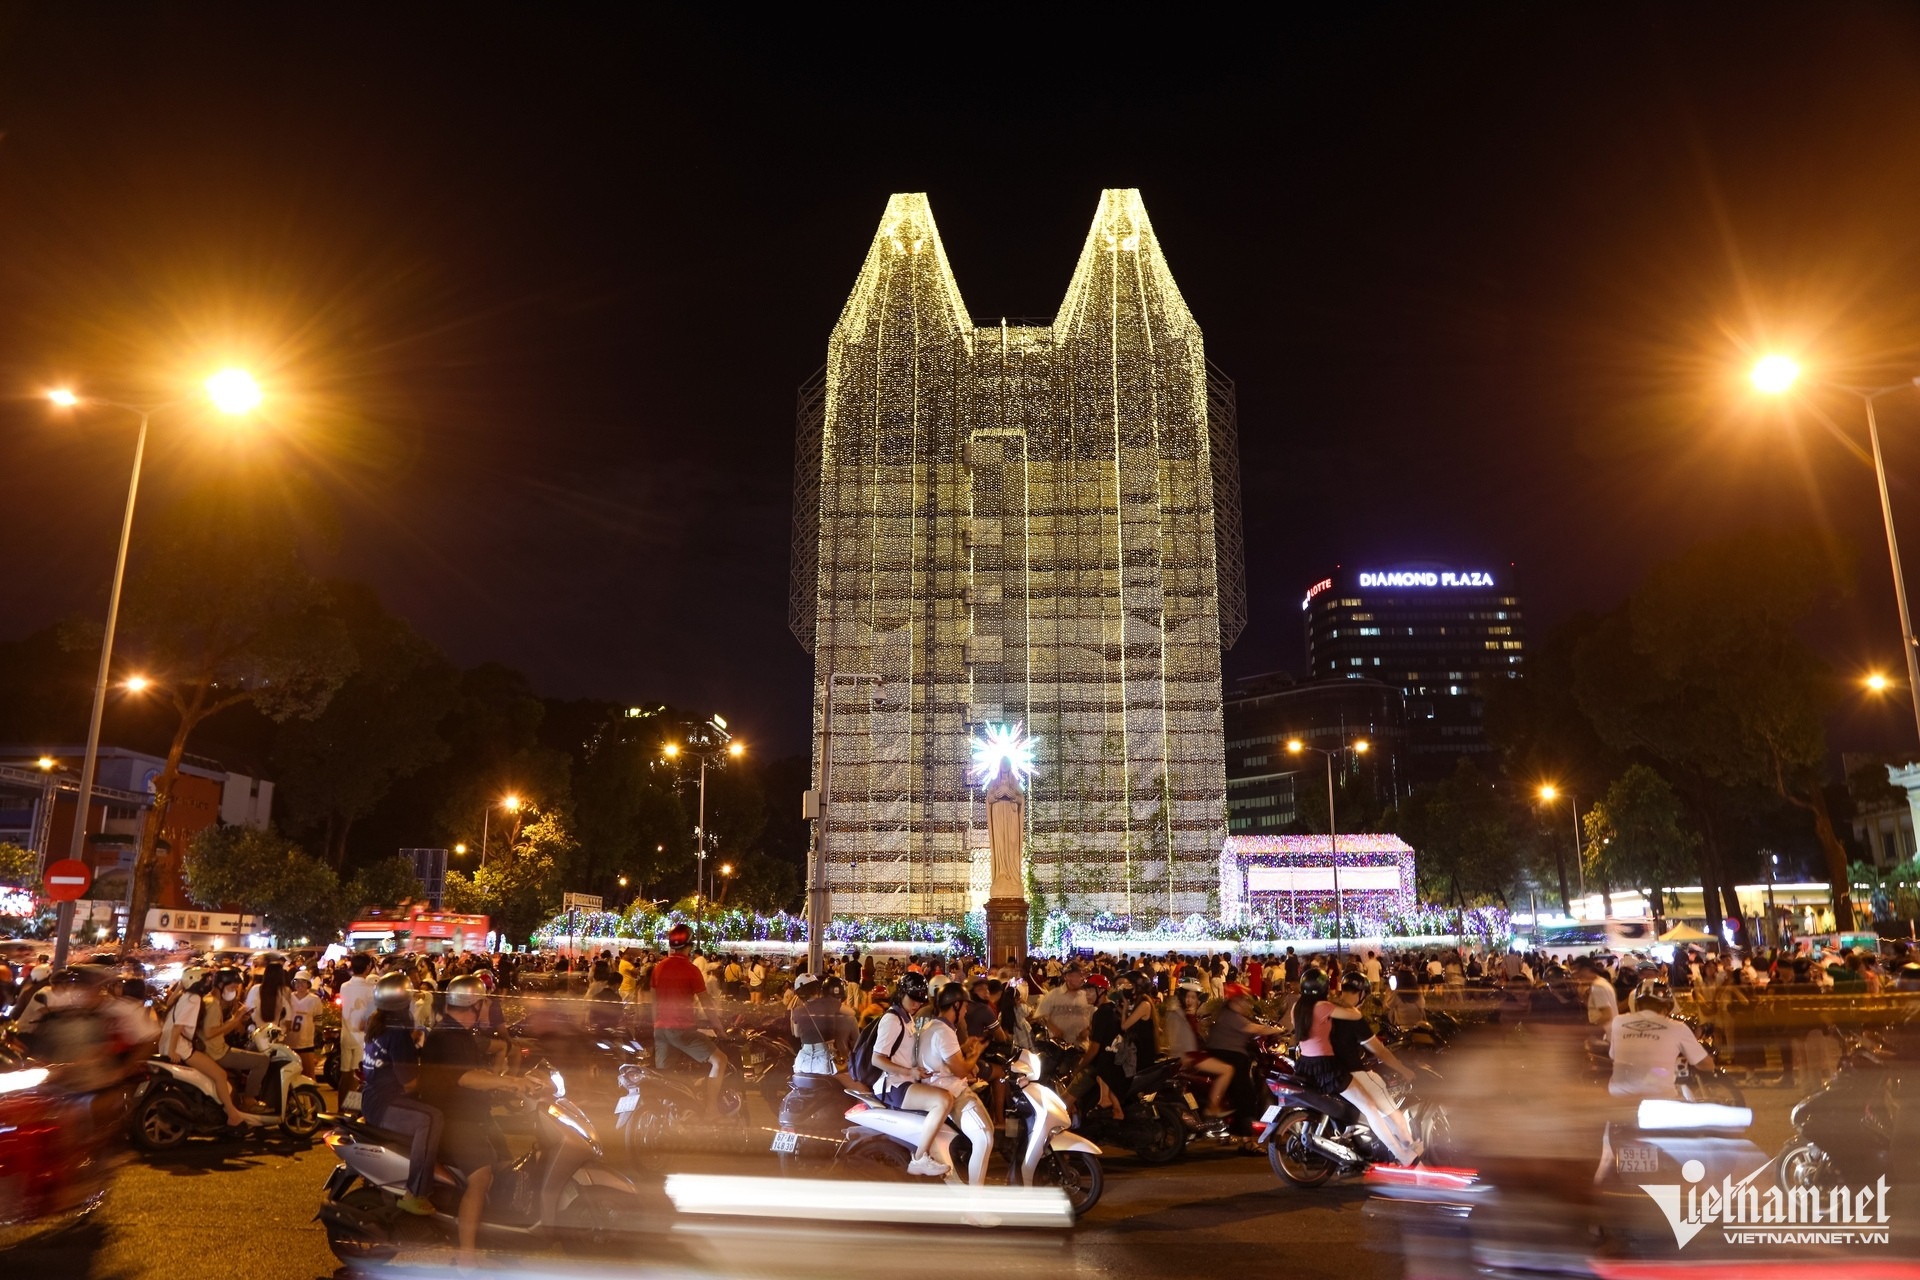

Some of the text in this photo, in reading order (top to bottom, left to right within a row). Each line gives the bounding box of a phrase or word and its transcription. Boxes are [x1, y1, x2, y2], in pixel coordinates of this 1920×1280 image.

[1360, 572, 1494, 587] DIAMOND PLAZA
[1310, 578, 1332, 597] LOTTE
[1623, 1031, 1660, 1040] umbro
